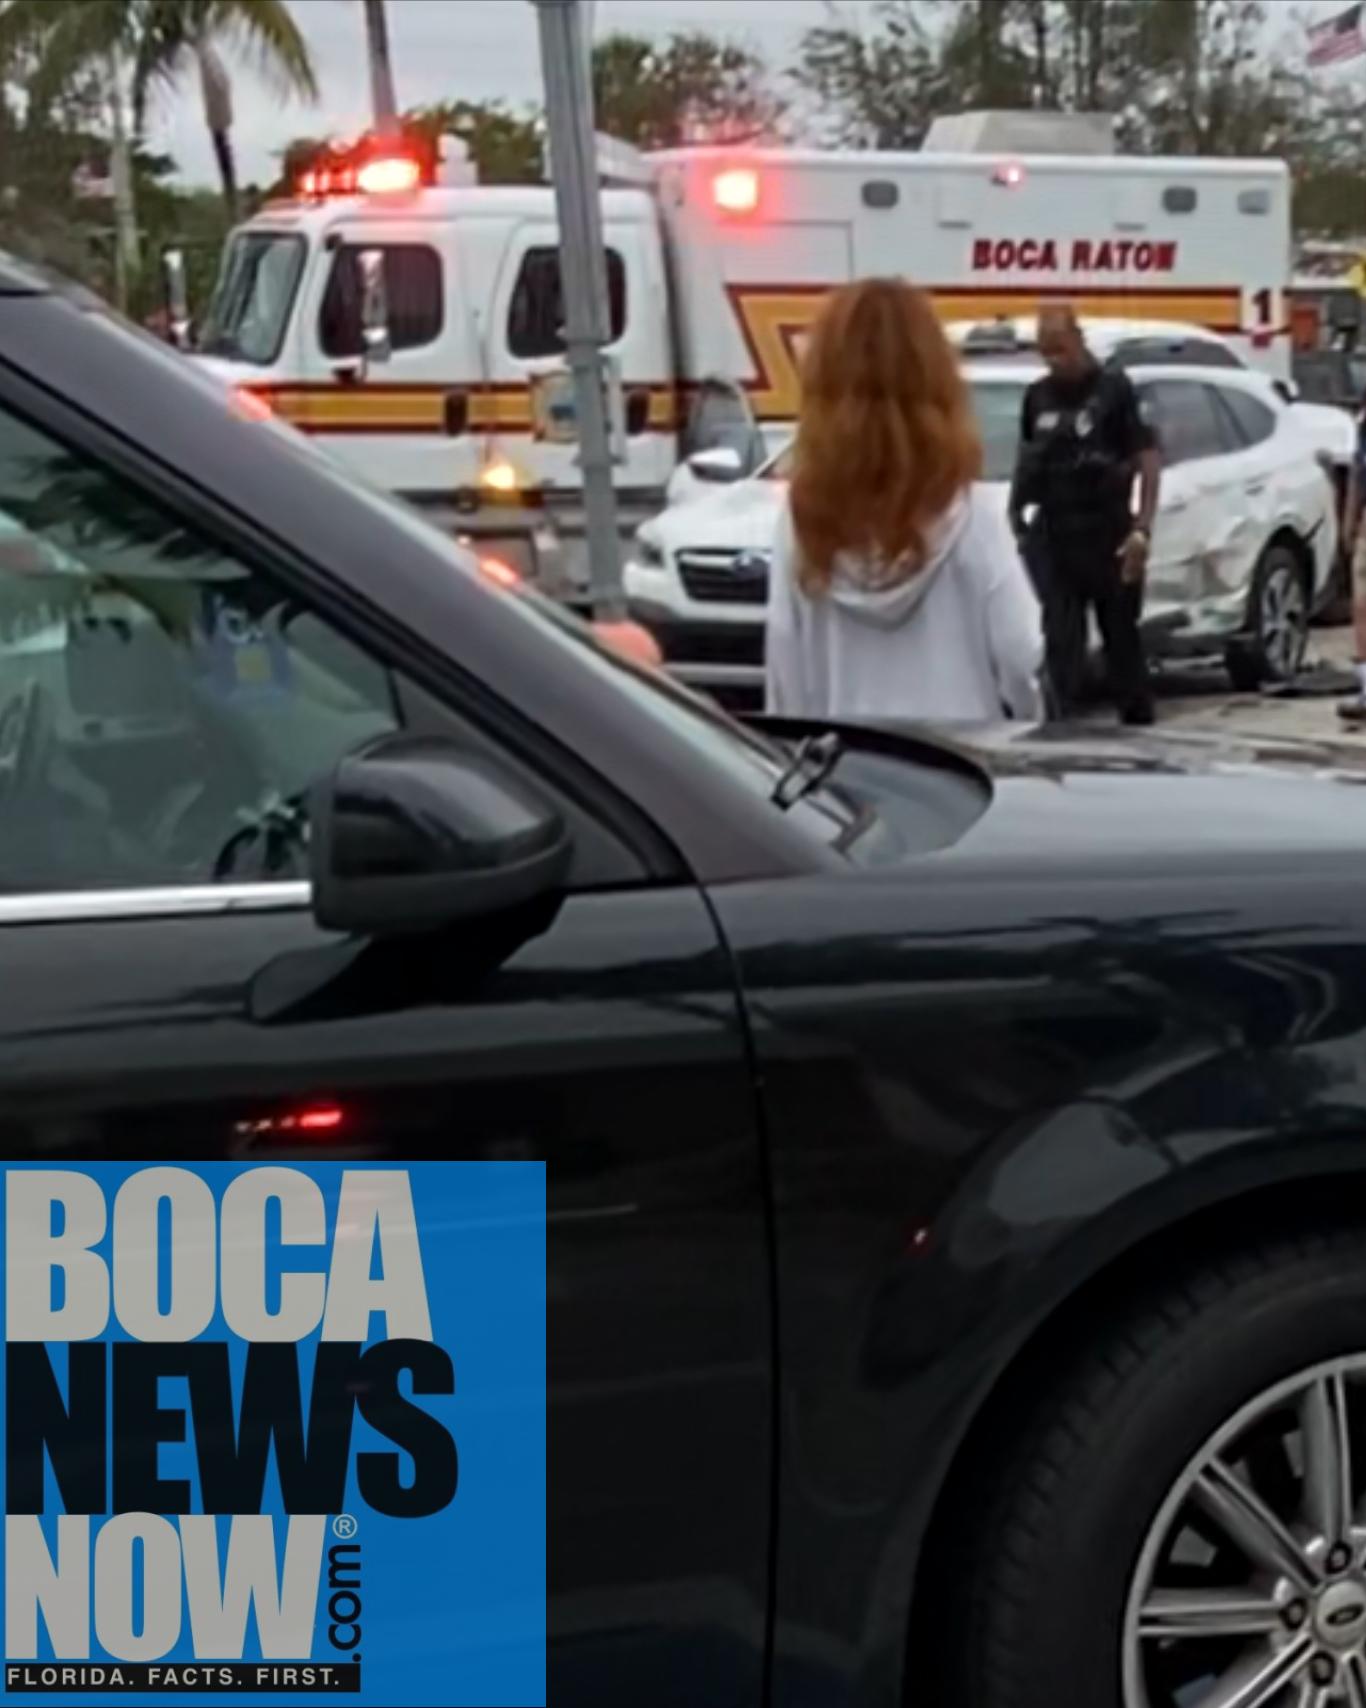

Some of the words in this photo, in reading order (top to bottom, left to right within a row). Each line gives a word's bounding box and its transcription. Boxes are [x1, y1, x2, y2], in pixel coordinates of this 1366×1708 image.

[972, 239, 1057, 271] BOCA
[1070, 240, 1177, 272] RATON
[1251, 288, 1271, 324] 1
